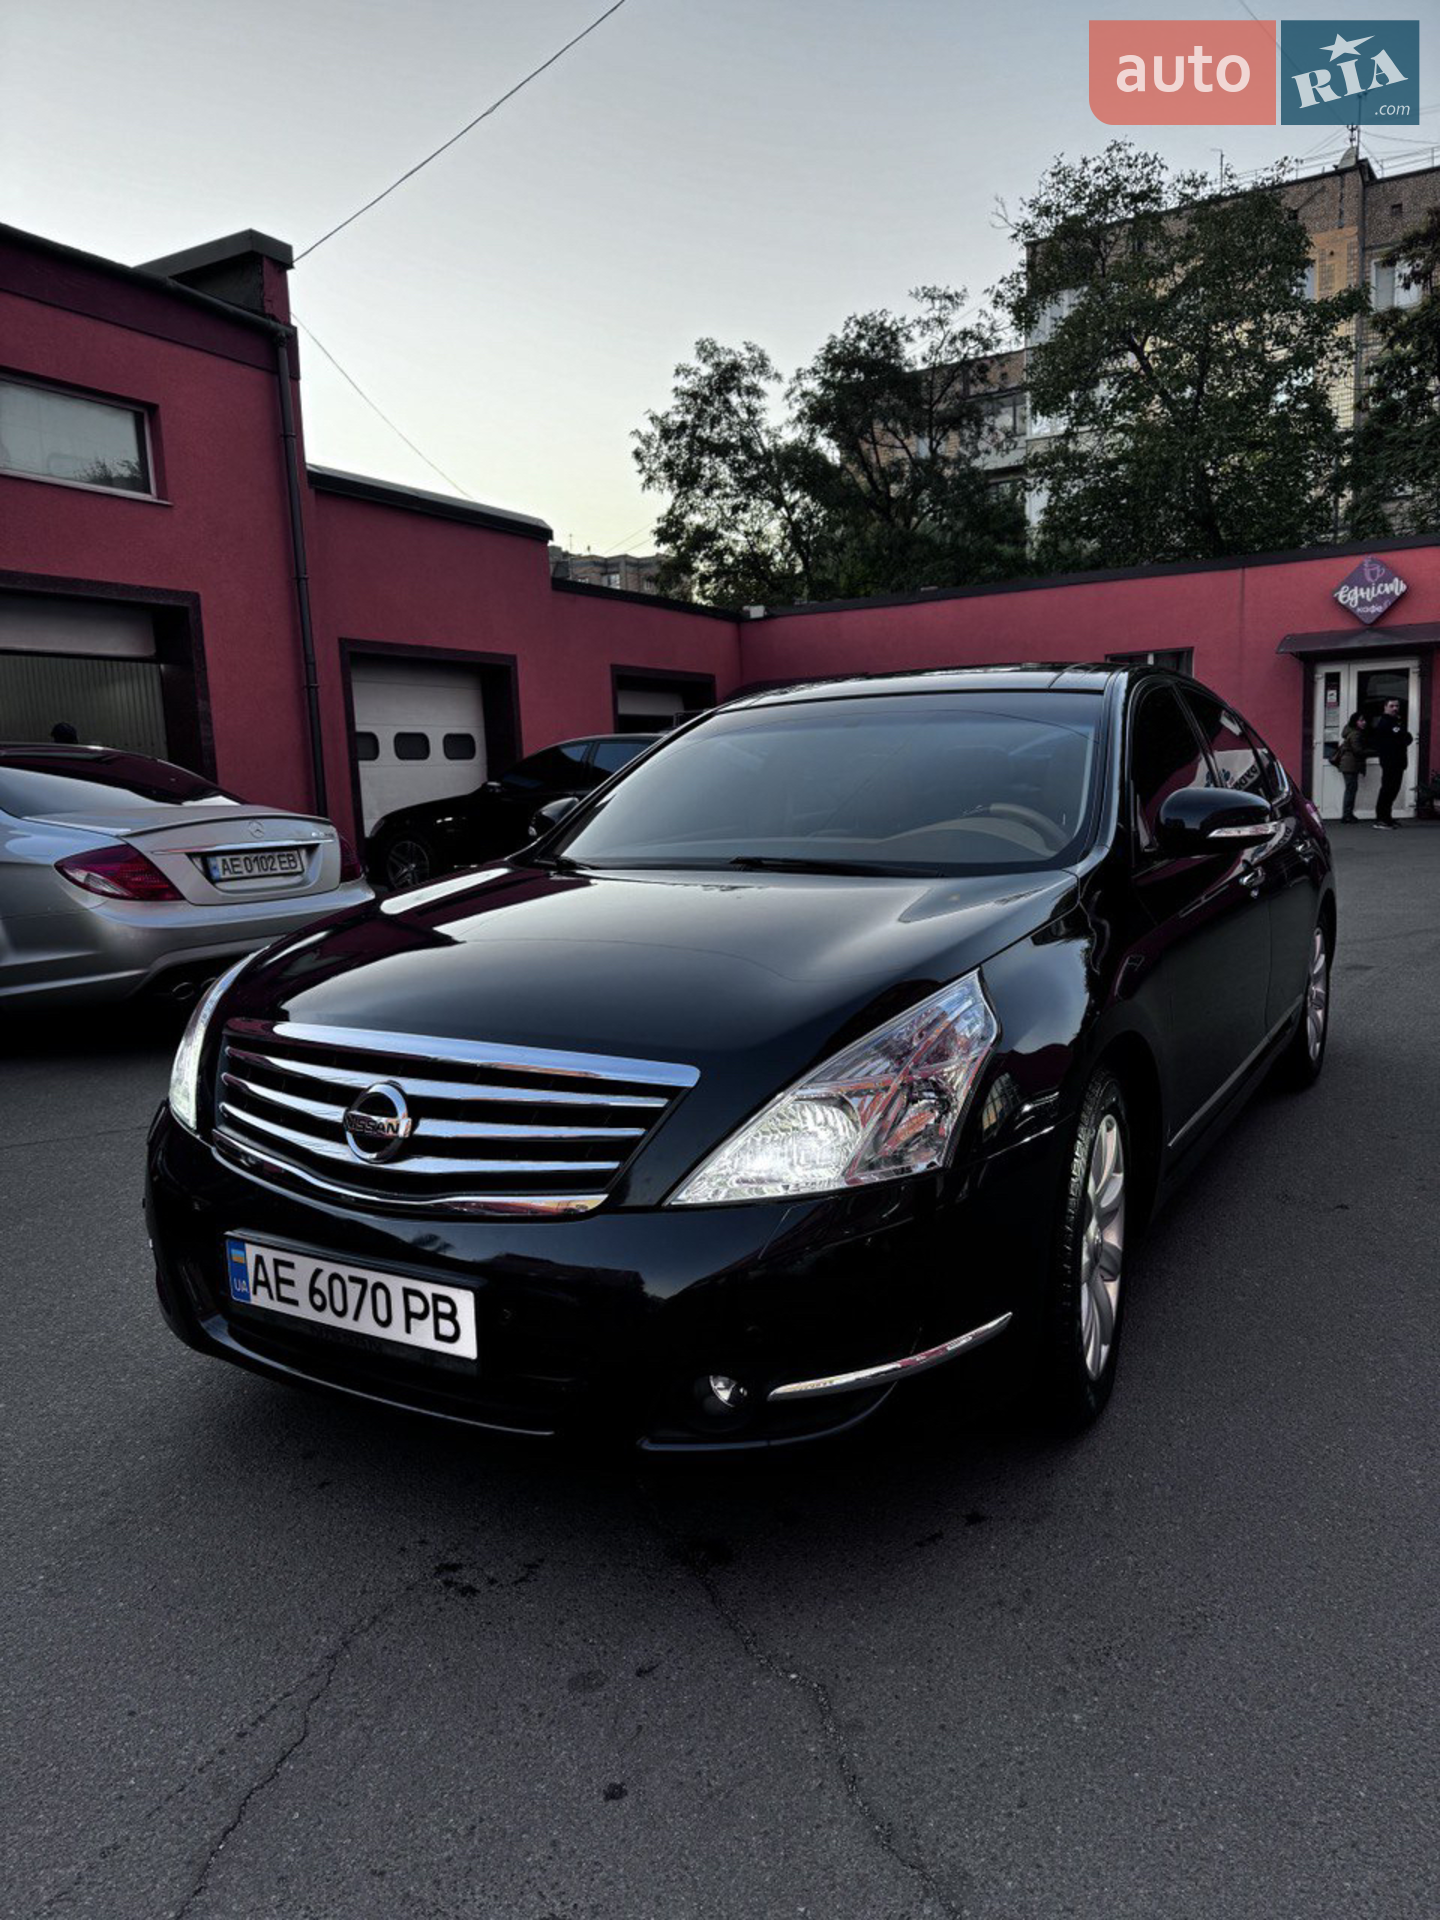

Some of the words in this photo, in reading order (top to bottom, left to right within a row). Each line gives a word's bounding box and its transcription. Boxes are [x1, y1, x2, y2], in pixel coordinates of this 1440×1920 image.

[221, 857, 243, 876] AE
[244, 854, 278, 874] 0102
[279, 853, 298, 870] EB
[345, 1112, 400, 1136] NISSAN
[234, 1279, 249, 1294] UA
[252, 1254, 299, 1307] AE
[308, 1267, 393, 1328] 6070
[402, 1286, 461, 1344] PB
